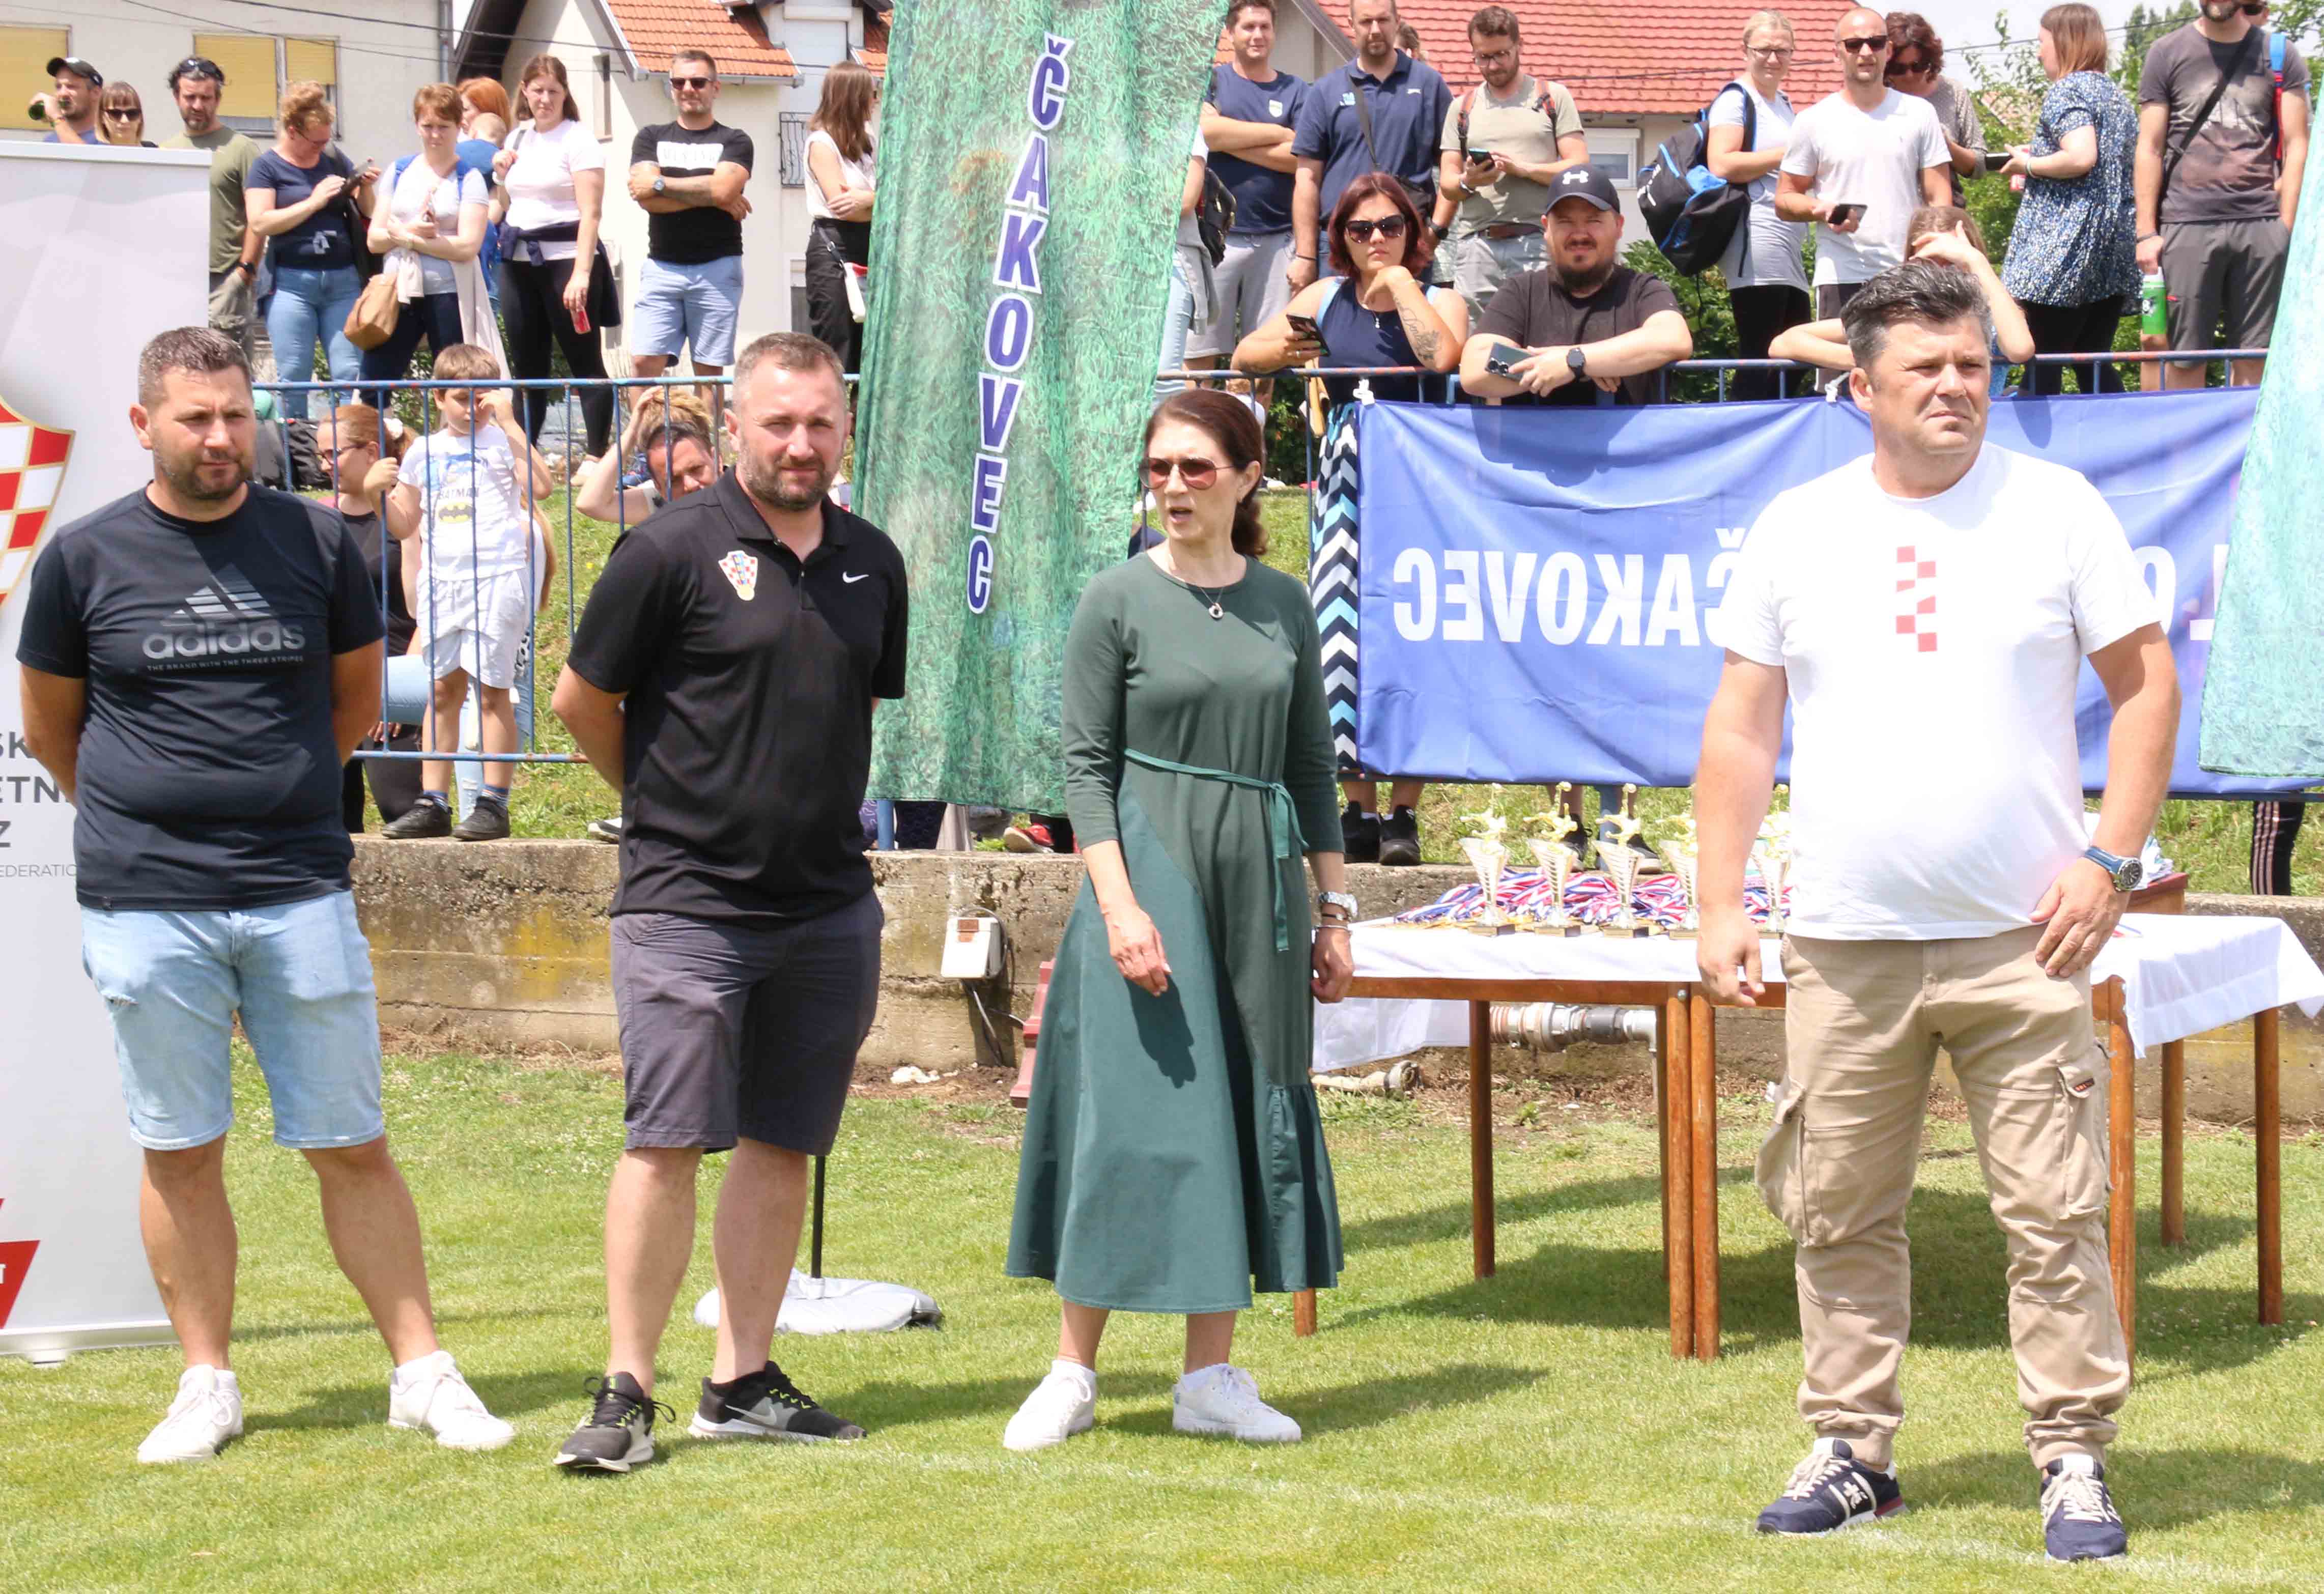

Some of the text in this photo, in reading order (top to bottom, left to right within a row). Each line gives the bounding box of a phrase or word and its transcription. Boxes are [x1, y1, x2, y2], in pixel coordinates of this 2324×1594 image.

[968, 32, 1074, 614] ČAKOVEC
[142, 619, 305, 660] adidas
[271, 655, 304, 663] STRIPES
